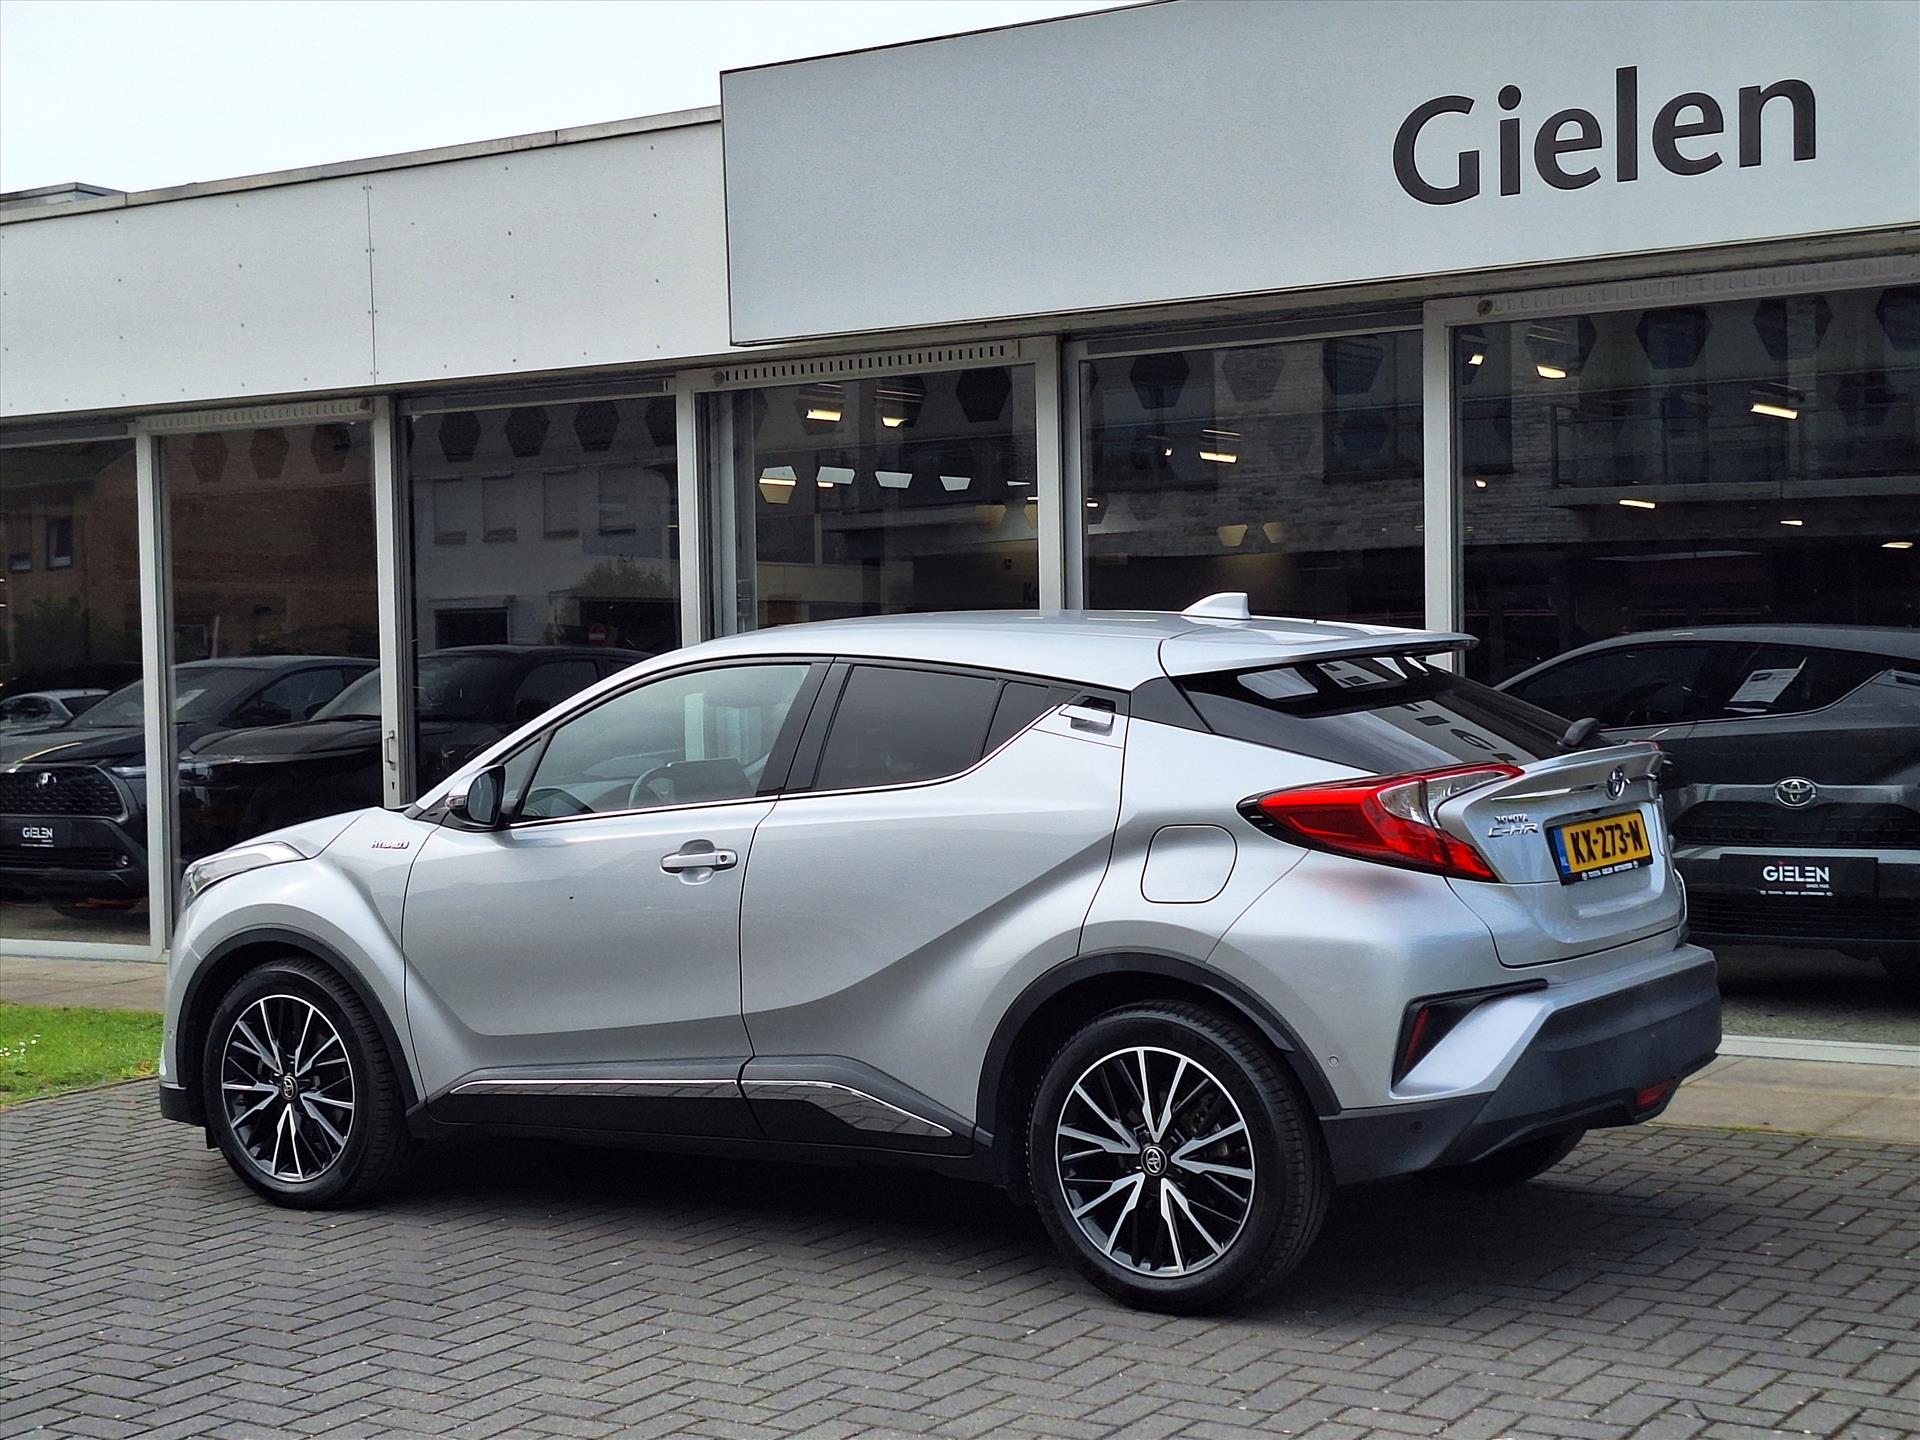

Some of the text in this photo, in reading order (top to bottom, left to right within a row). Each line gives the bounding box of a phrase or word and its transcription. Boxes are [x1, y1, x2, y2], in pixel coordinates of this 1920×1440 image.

[1392, 65, 1816, 205] Gielen
[22, 827, 53, 839] GIELEN
[1488, 823, 1539, 838] C-HR
[1569, 819, 1644, 866] KX-273-N
[1762, 865, 1830, 883] GIELEN
